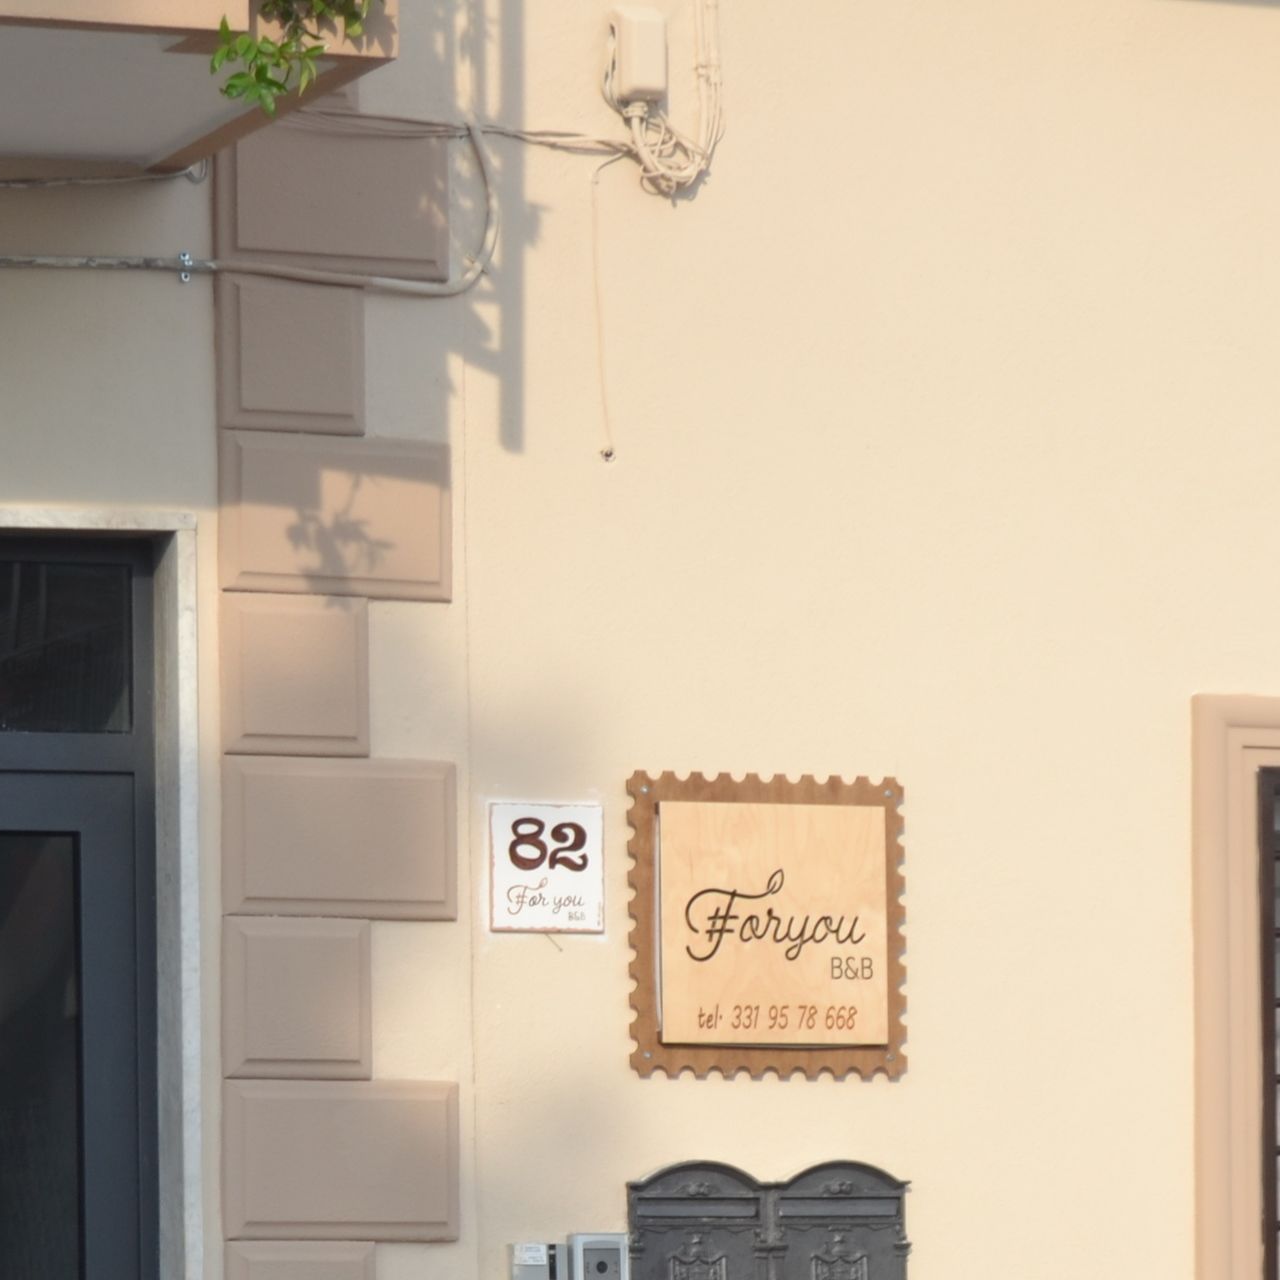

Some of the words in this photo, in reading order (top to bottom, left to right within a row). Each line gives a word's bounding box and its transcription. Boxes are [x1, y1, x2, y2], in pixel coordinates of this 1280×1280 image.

[508, 816, 589, 873] 82
[830, 956, 874, 980] B&B
[731, 1004, 760, 1030] 331
[768, 1004, 790, 1030] 95
[797, 1005, 818, 1030] 78
[825, 1005, 858, 1031] 668
